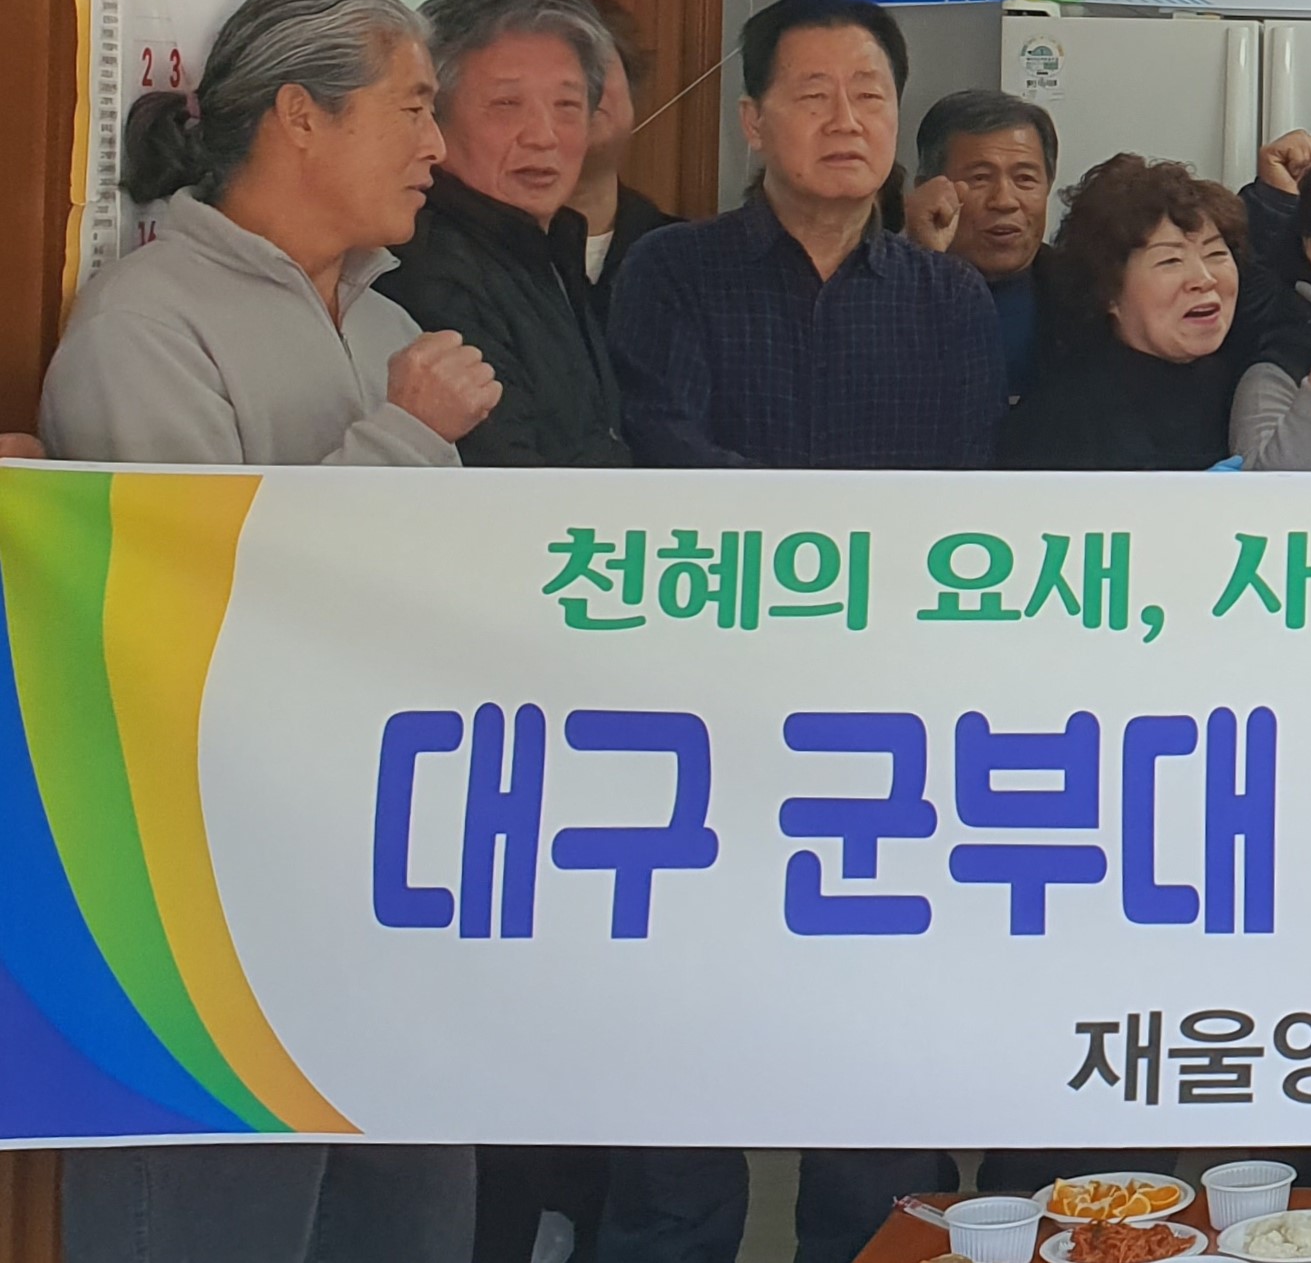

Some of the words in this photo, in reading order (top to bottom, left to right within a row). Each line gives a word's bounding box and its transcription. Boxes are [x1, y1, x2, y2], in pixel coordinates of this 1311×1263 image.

[141, 47, 153, 87] 2
[169, 48, 181, 87] 3
[543, 528, 871, 631] 천혜의
[917, 532, 1164, 643] 요새,
[373, 702, 719, 939] 대구
[779, 707, 1277, 936] 군부대
